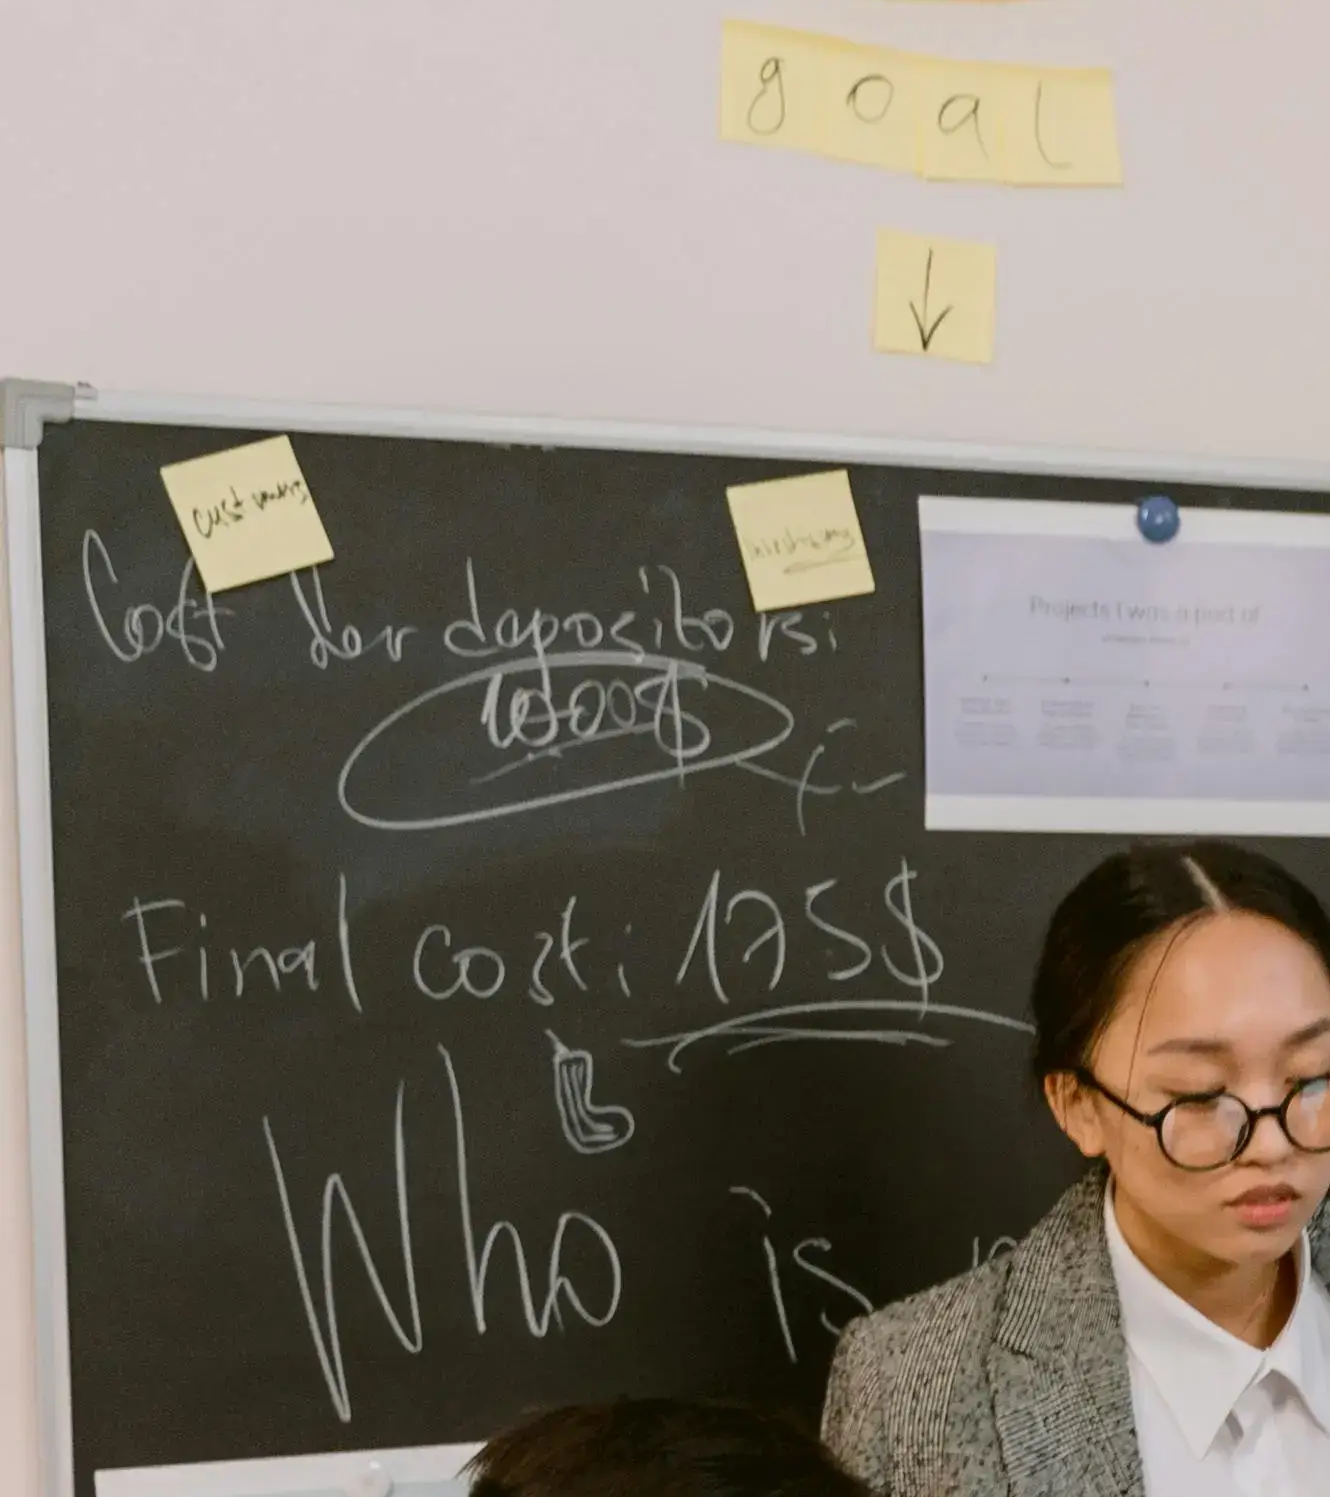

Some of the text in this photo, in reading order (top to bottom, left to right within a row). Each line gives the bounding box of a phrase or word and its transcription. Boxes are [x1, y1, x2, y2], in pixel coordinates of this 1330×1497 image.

[747, 56, 1075, 169] goal
[122, 873, 363, 1012] Final
[677, 857, 944, 1019] 175$
[262, 1042, 622, 1423] Who
[729, 1185, 874, 1364] is
